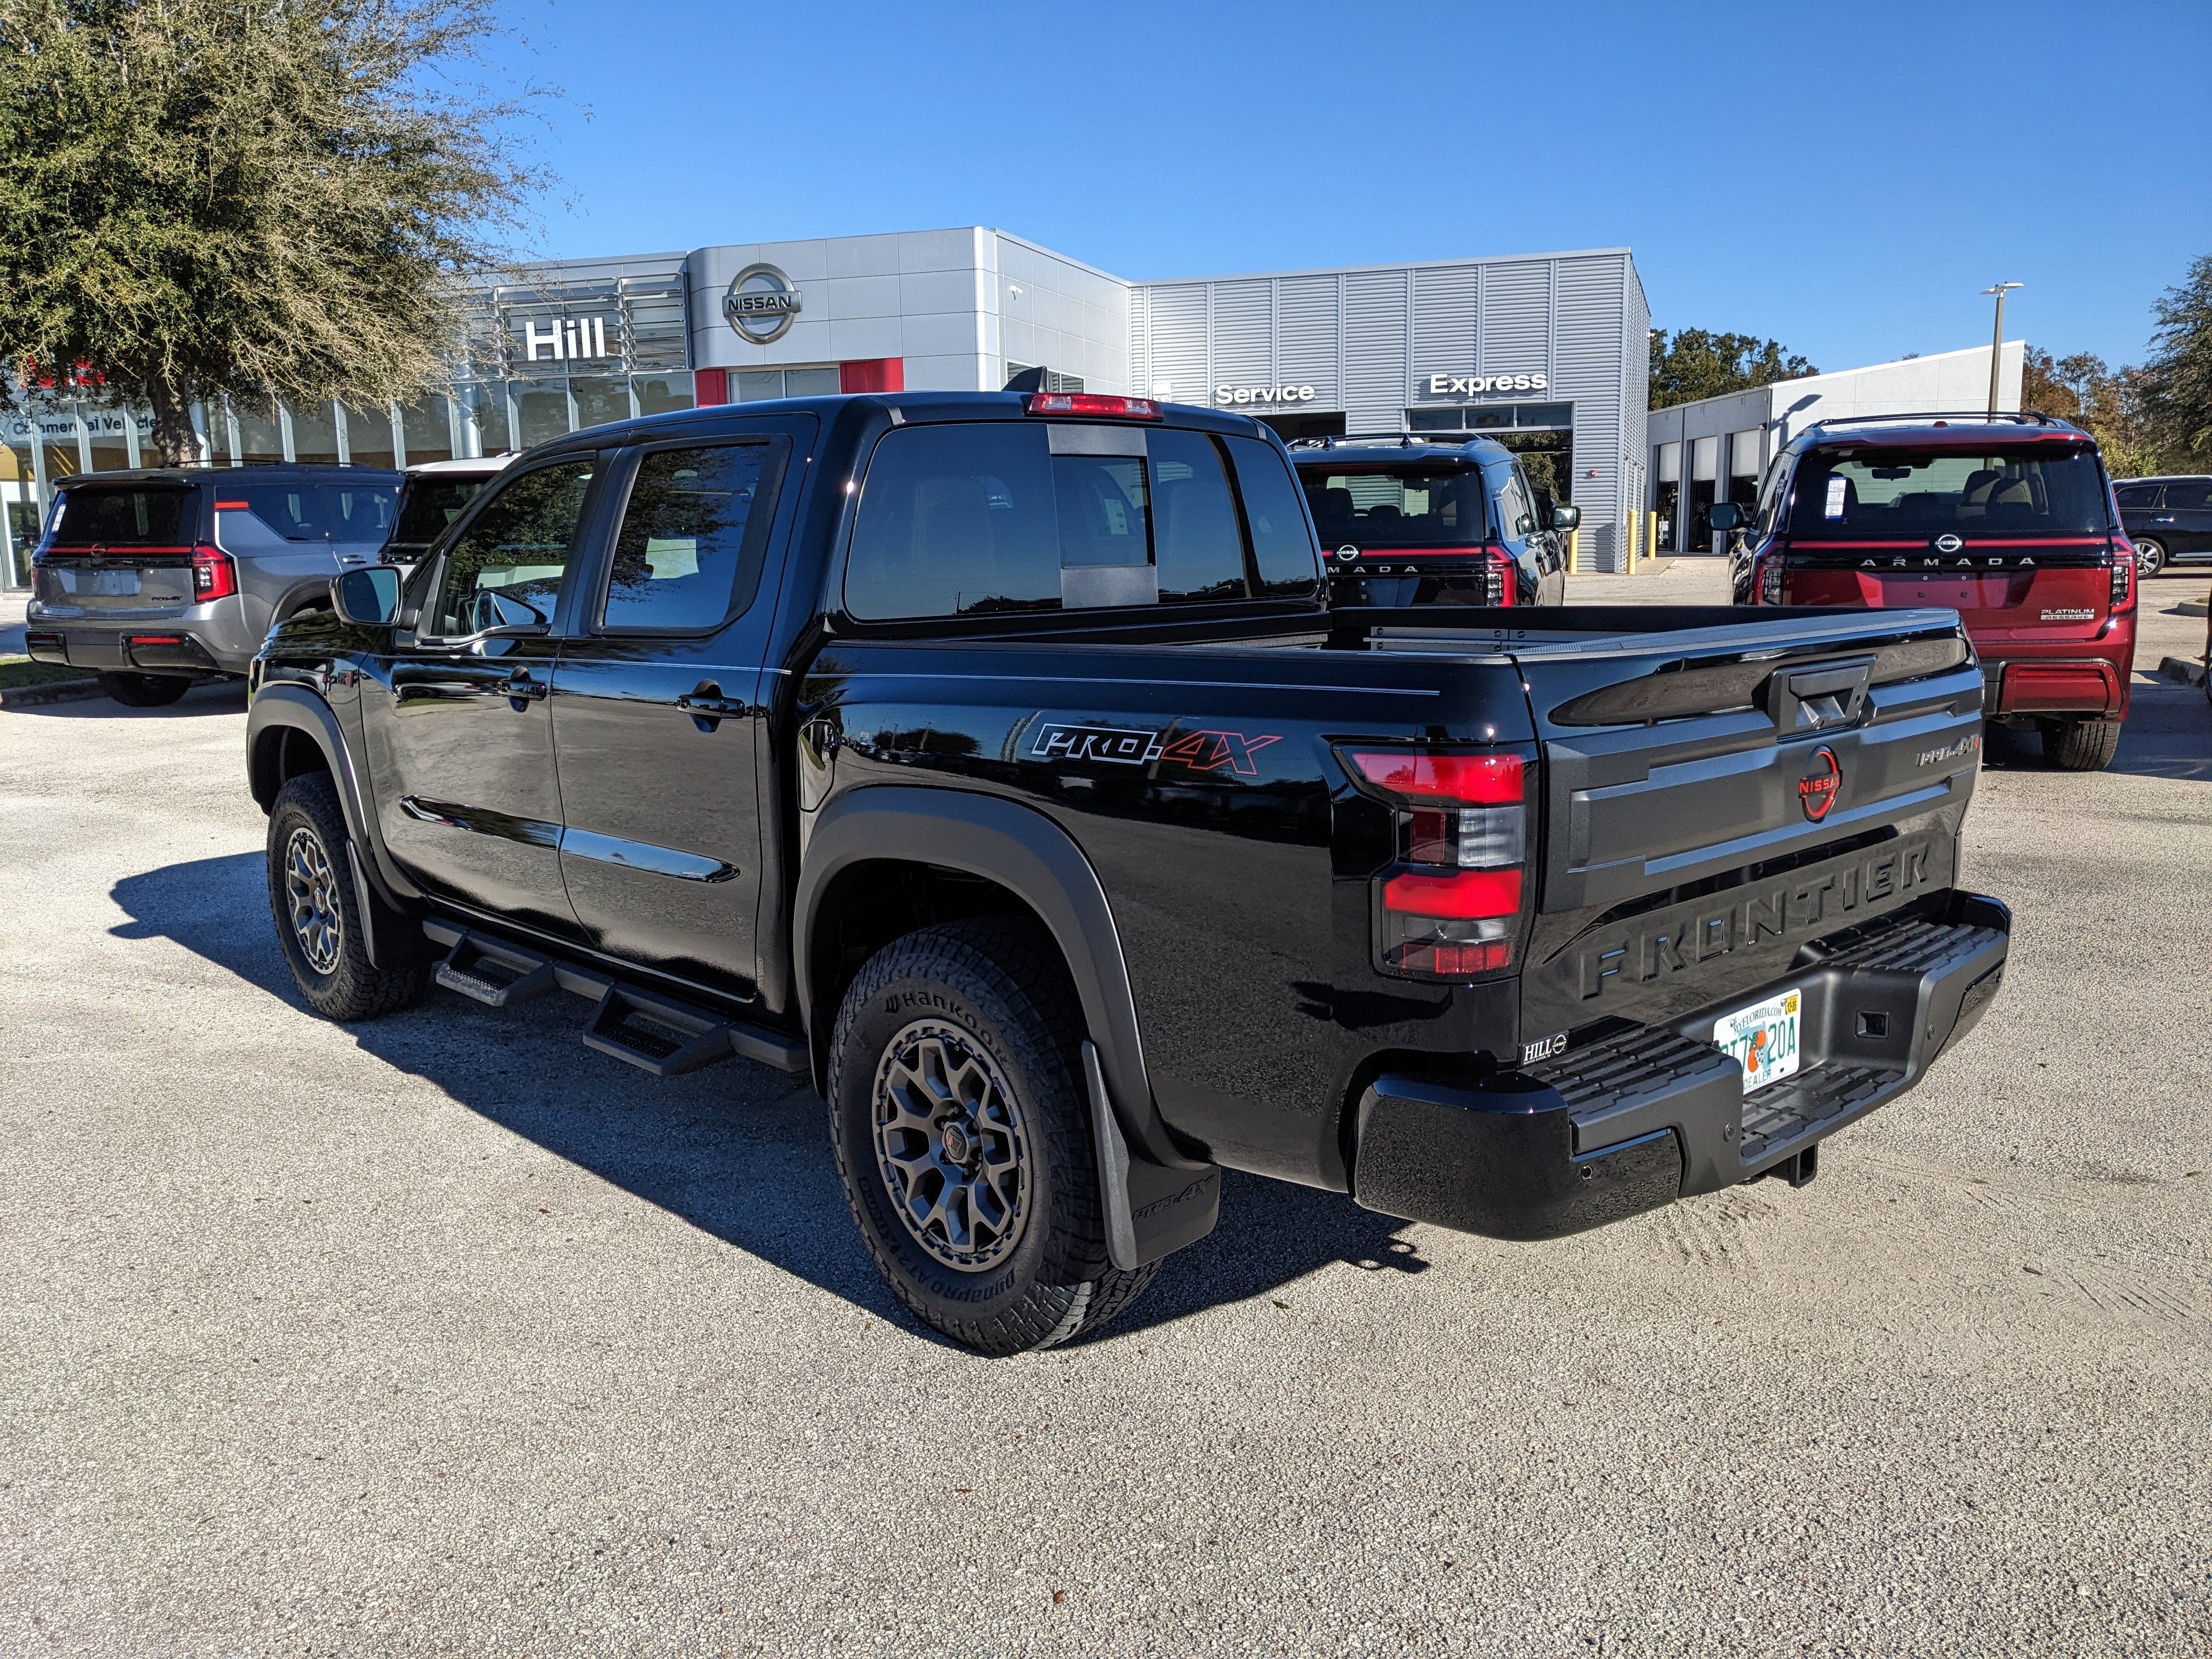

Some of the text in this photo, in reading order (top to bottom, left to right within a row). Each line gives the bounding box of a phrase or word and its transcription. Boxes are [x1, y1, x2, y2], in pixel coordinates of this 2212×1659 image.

[728, 296, 791, 311] NISSAN
[526, 317, 606, 361] Hill
[1215, 383, 1316, 404] Service
[1430, 374, 1548, 397] Express
[1860, 557, 2035, 567] ARMADA
[1031, 723, 1283, 776] PRO-4X
[1799, 777, 1840, 794] NISSAN
[1578, 842, 1930, 1001] FRONTIER
[1523, 1039, 1552, 1062] HILL
[1768, 1016, 1796, 1065] 20A
[1743, 1069, 1771, 1090] DEALER
